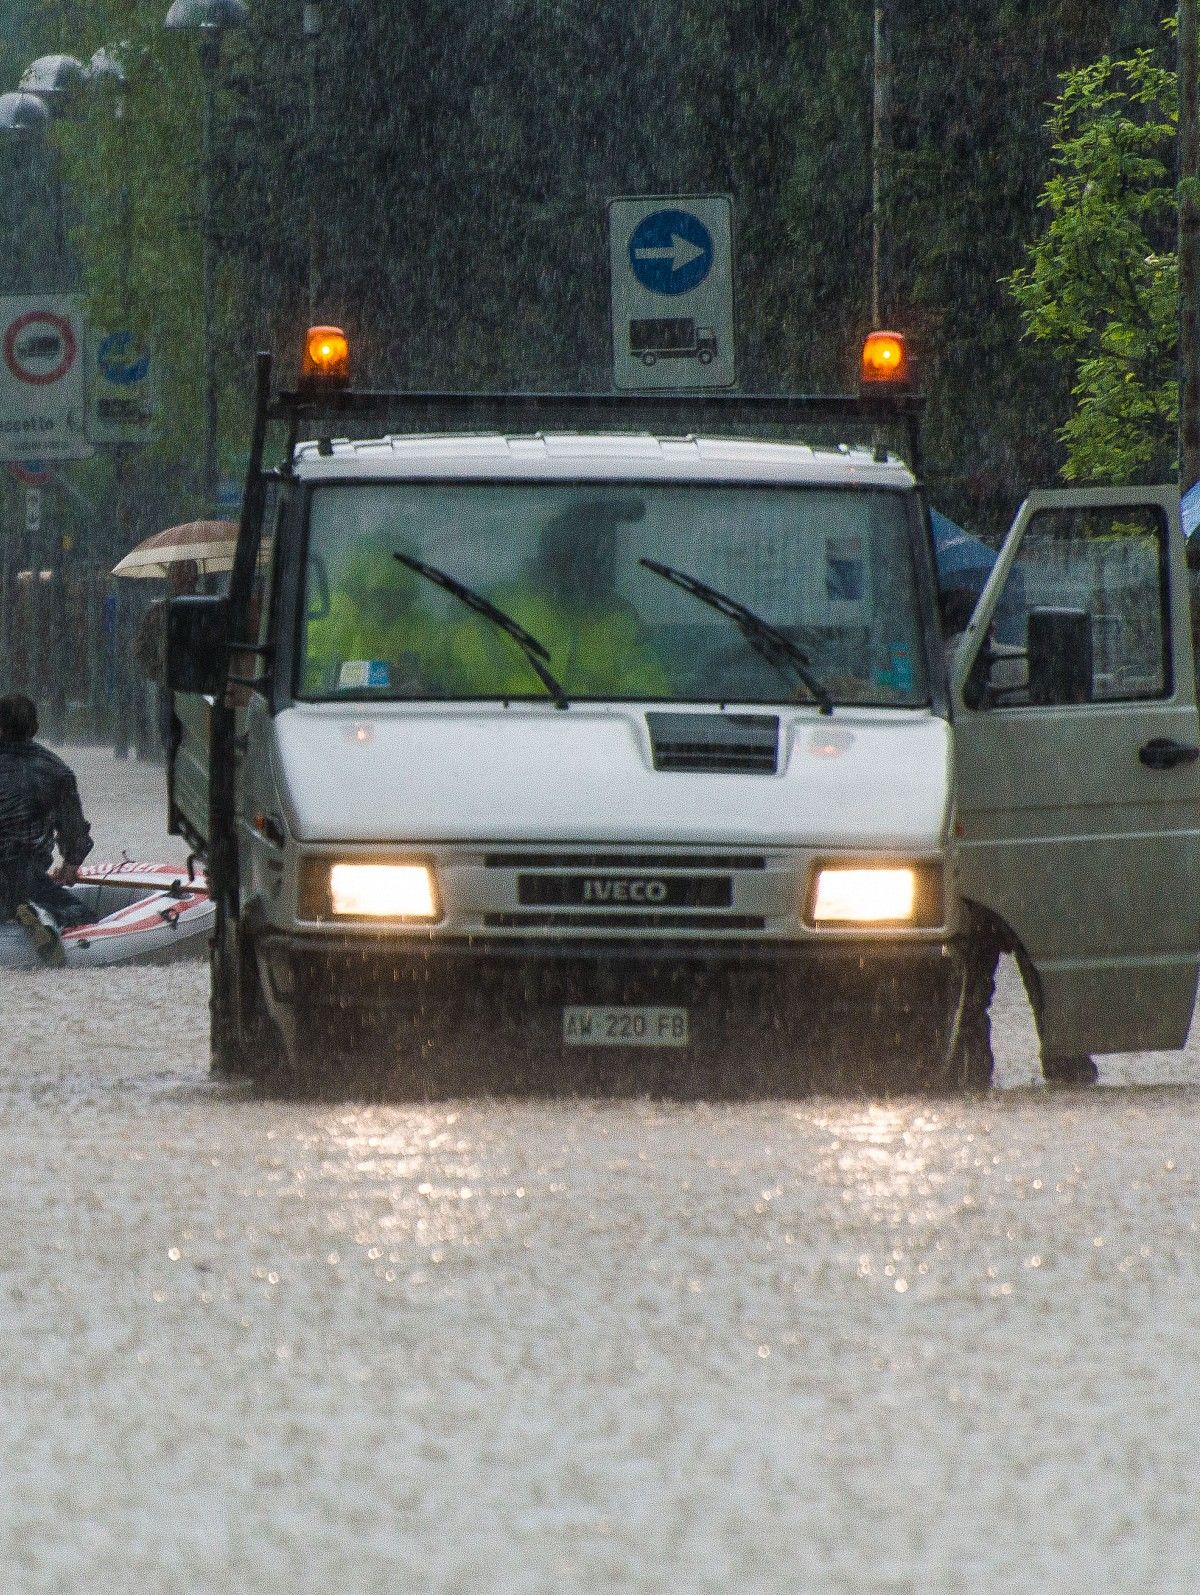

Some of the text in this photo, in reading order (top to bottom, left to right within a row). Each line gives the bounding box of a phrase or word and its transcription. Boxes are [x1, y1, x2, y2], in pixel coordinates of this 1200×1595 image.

[583, 880, 668, 902] IVECO
[566, 1013, 685, 1039] AW 220 FB
